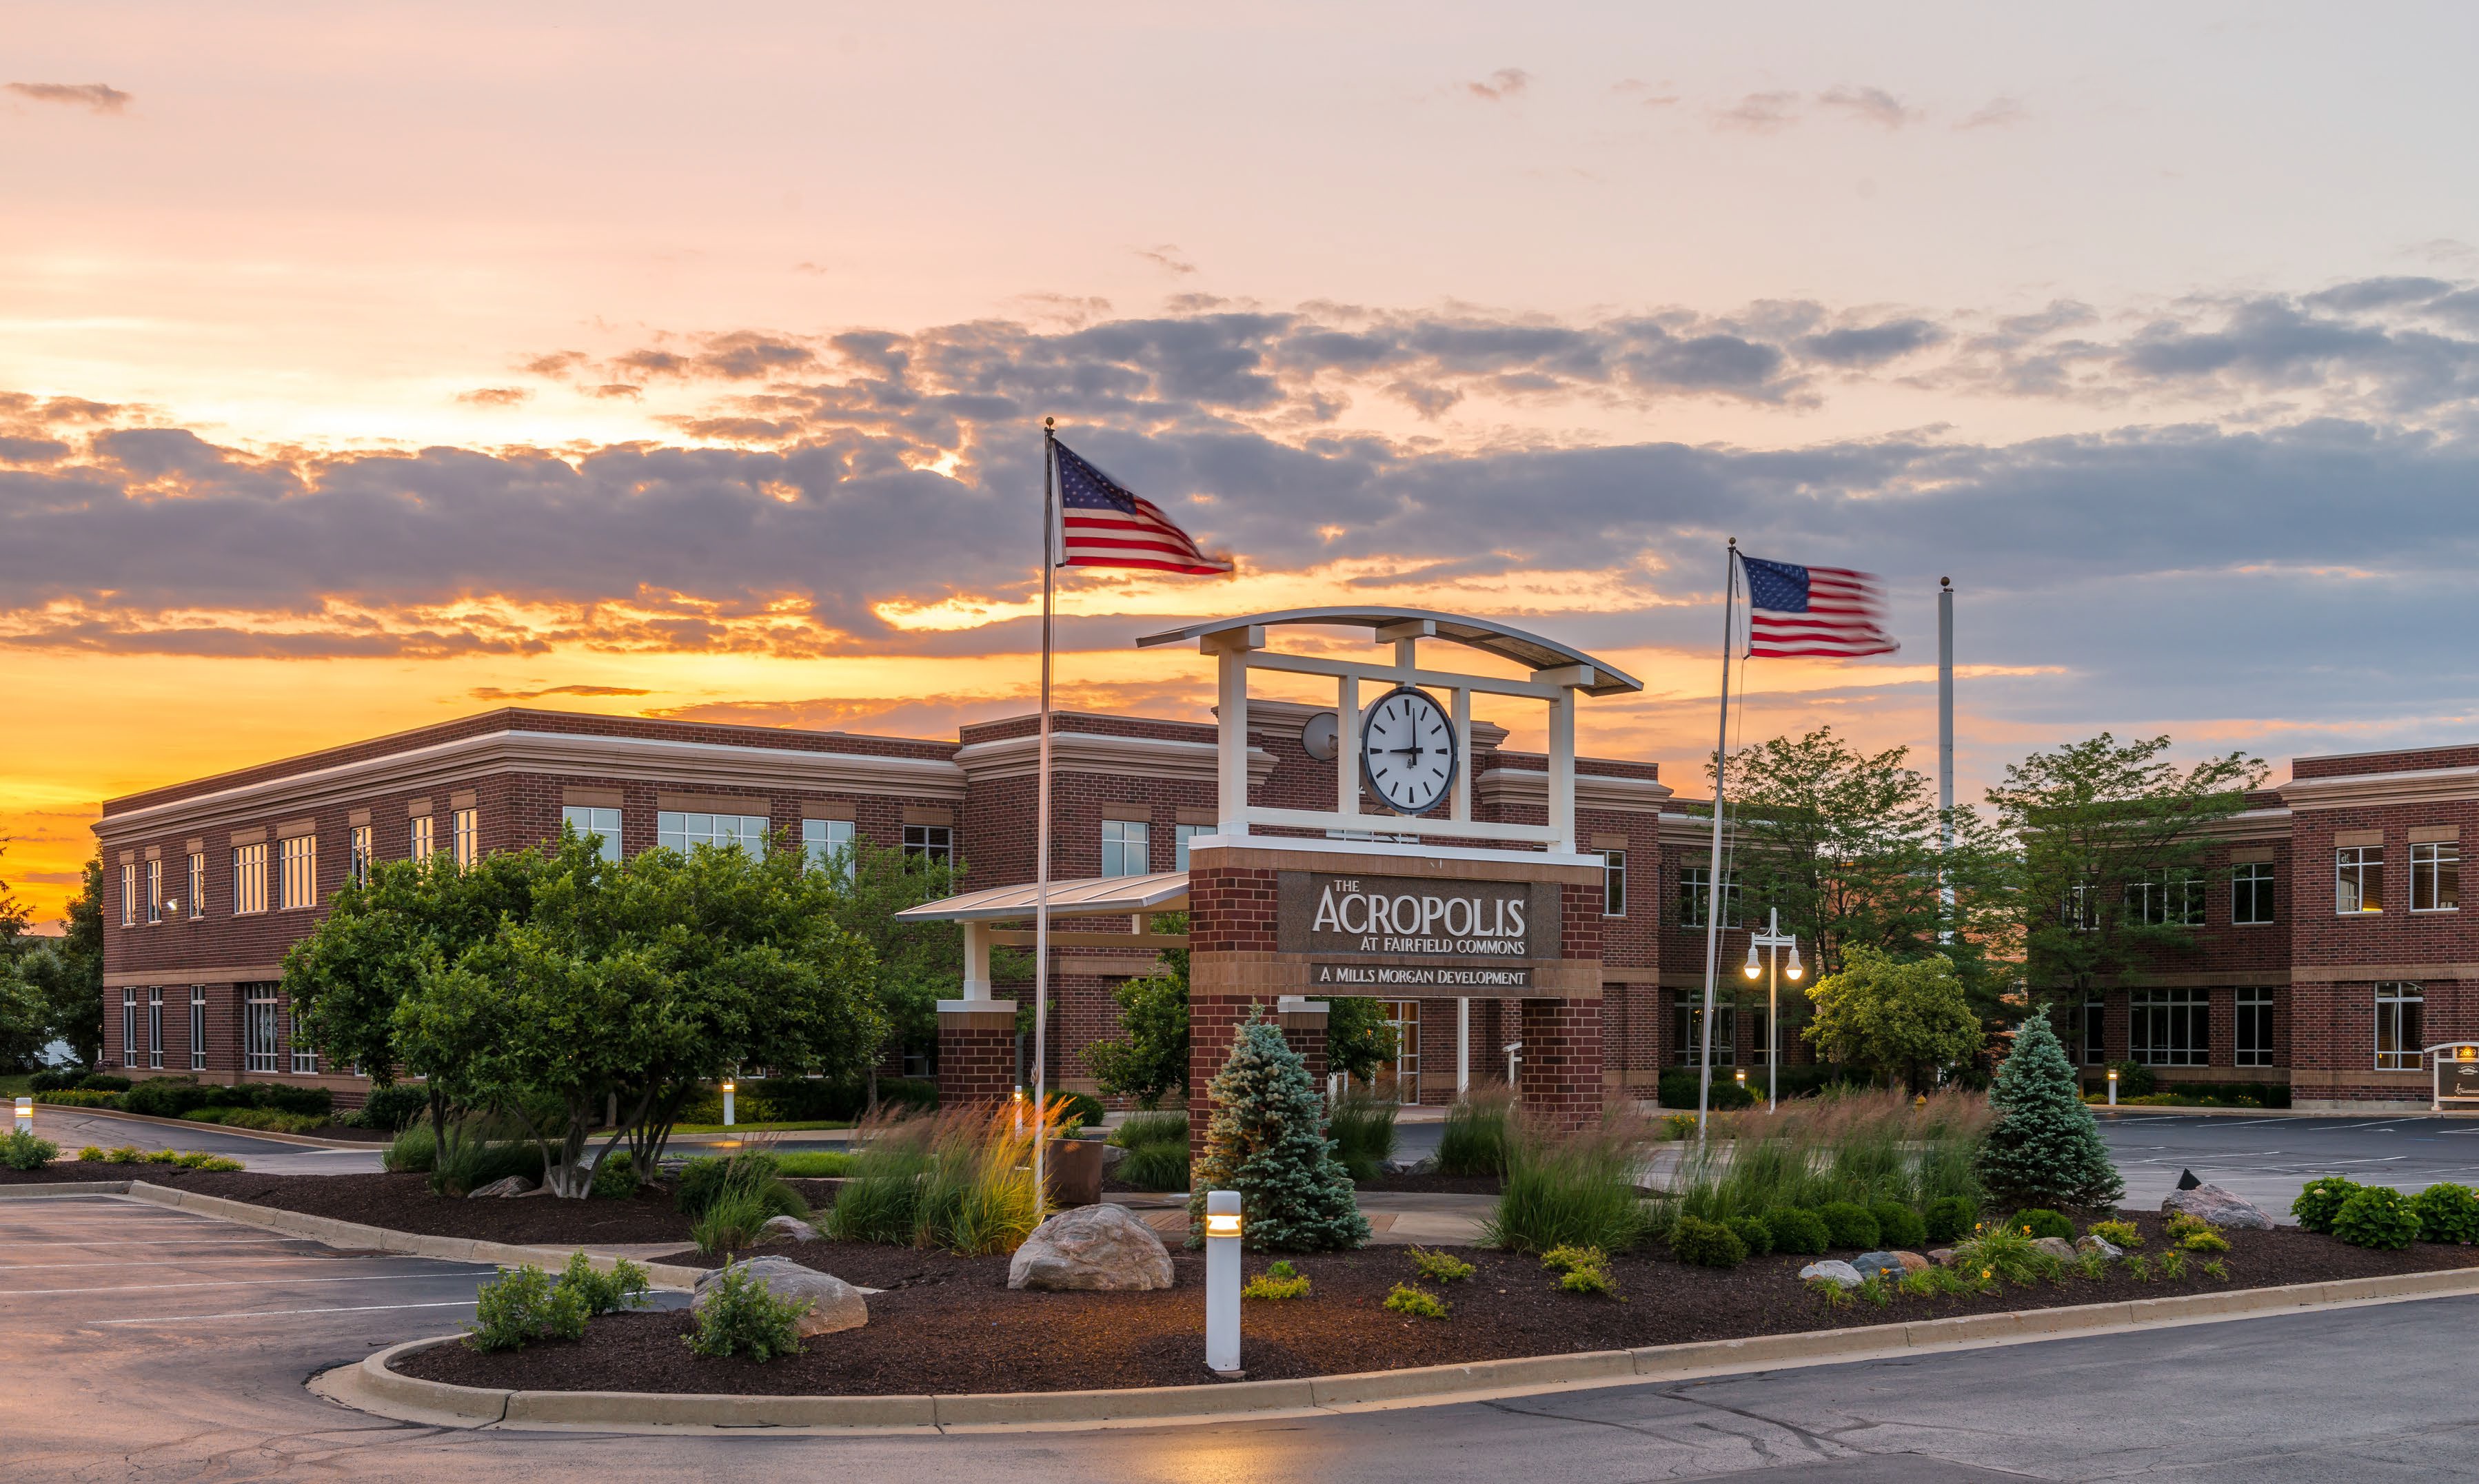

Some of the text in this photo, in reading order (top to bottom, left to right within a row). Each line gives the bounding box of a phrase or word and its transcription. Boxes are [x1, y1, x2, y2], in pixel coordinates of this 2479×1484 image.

[1333, 880, 1359, 892] THE
[1312, 884, 1526, 937] ACROPOLIS
[1360, 936, 1526, 955] AT FAIRFIELD COMMONS
[1319, 966, 1526, 986] A MILLS MORGAN DEVELOPMENT
